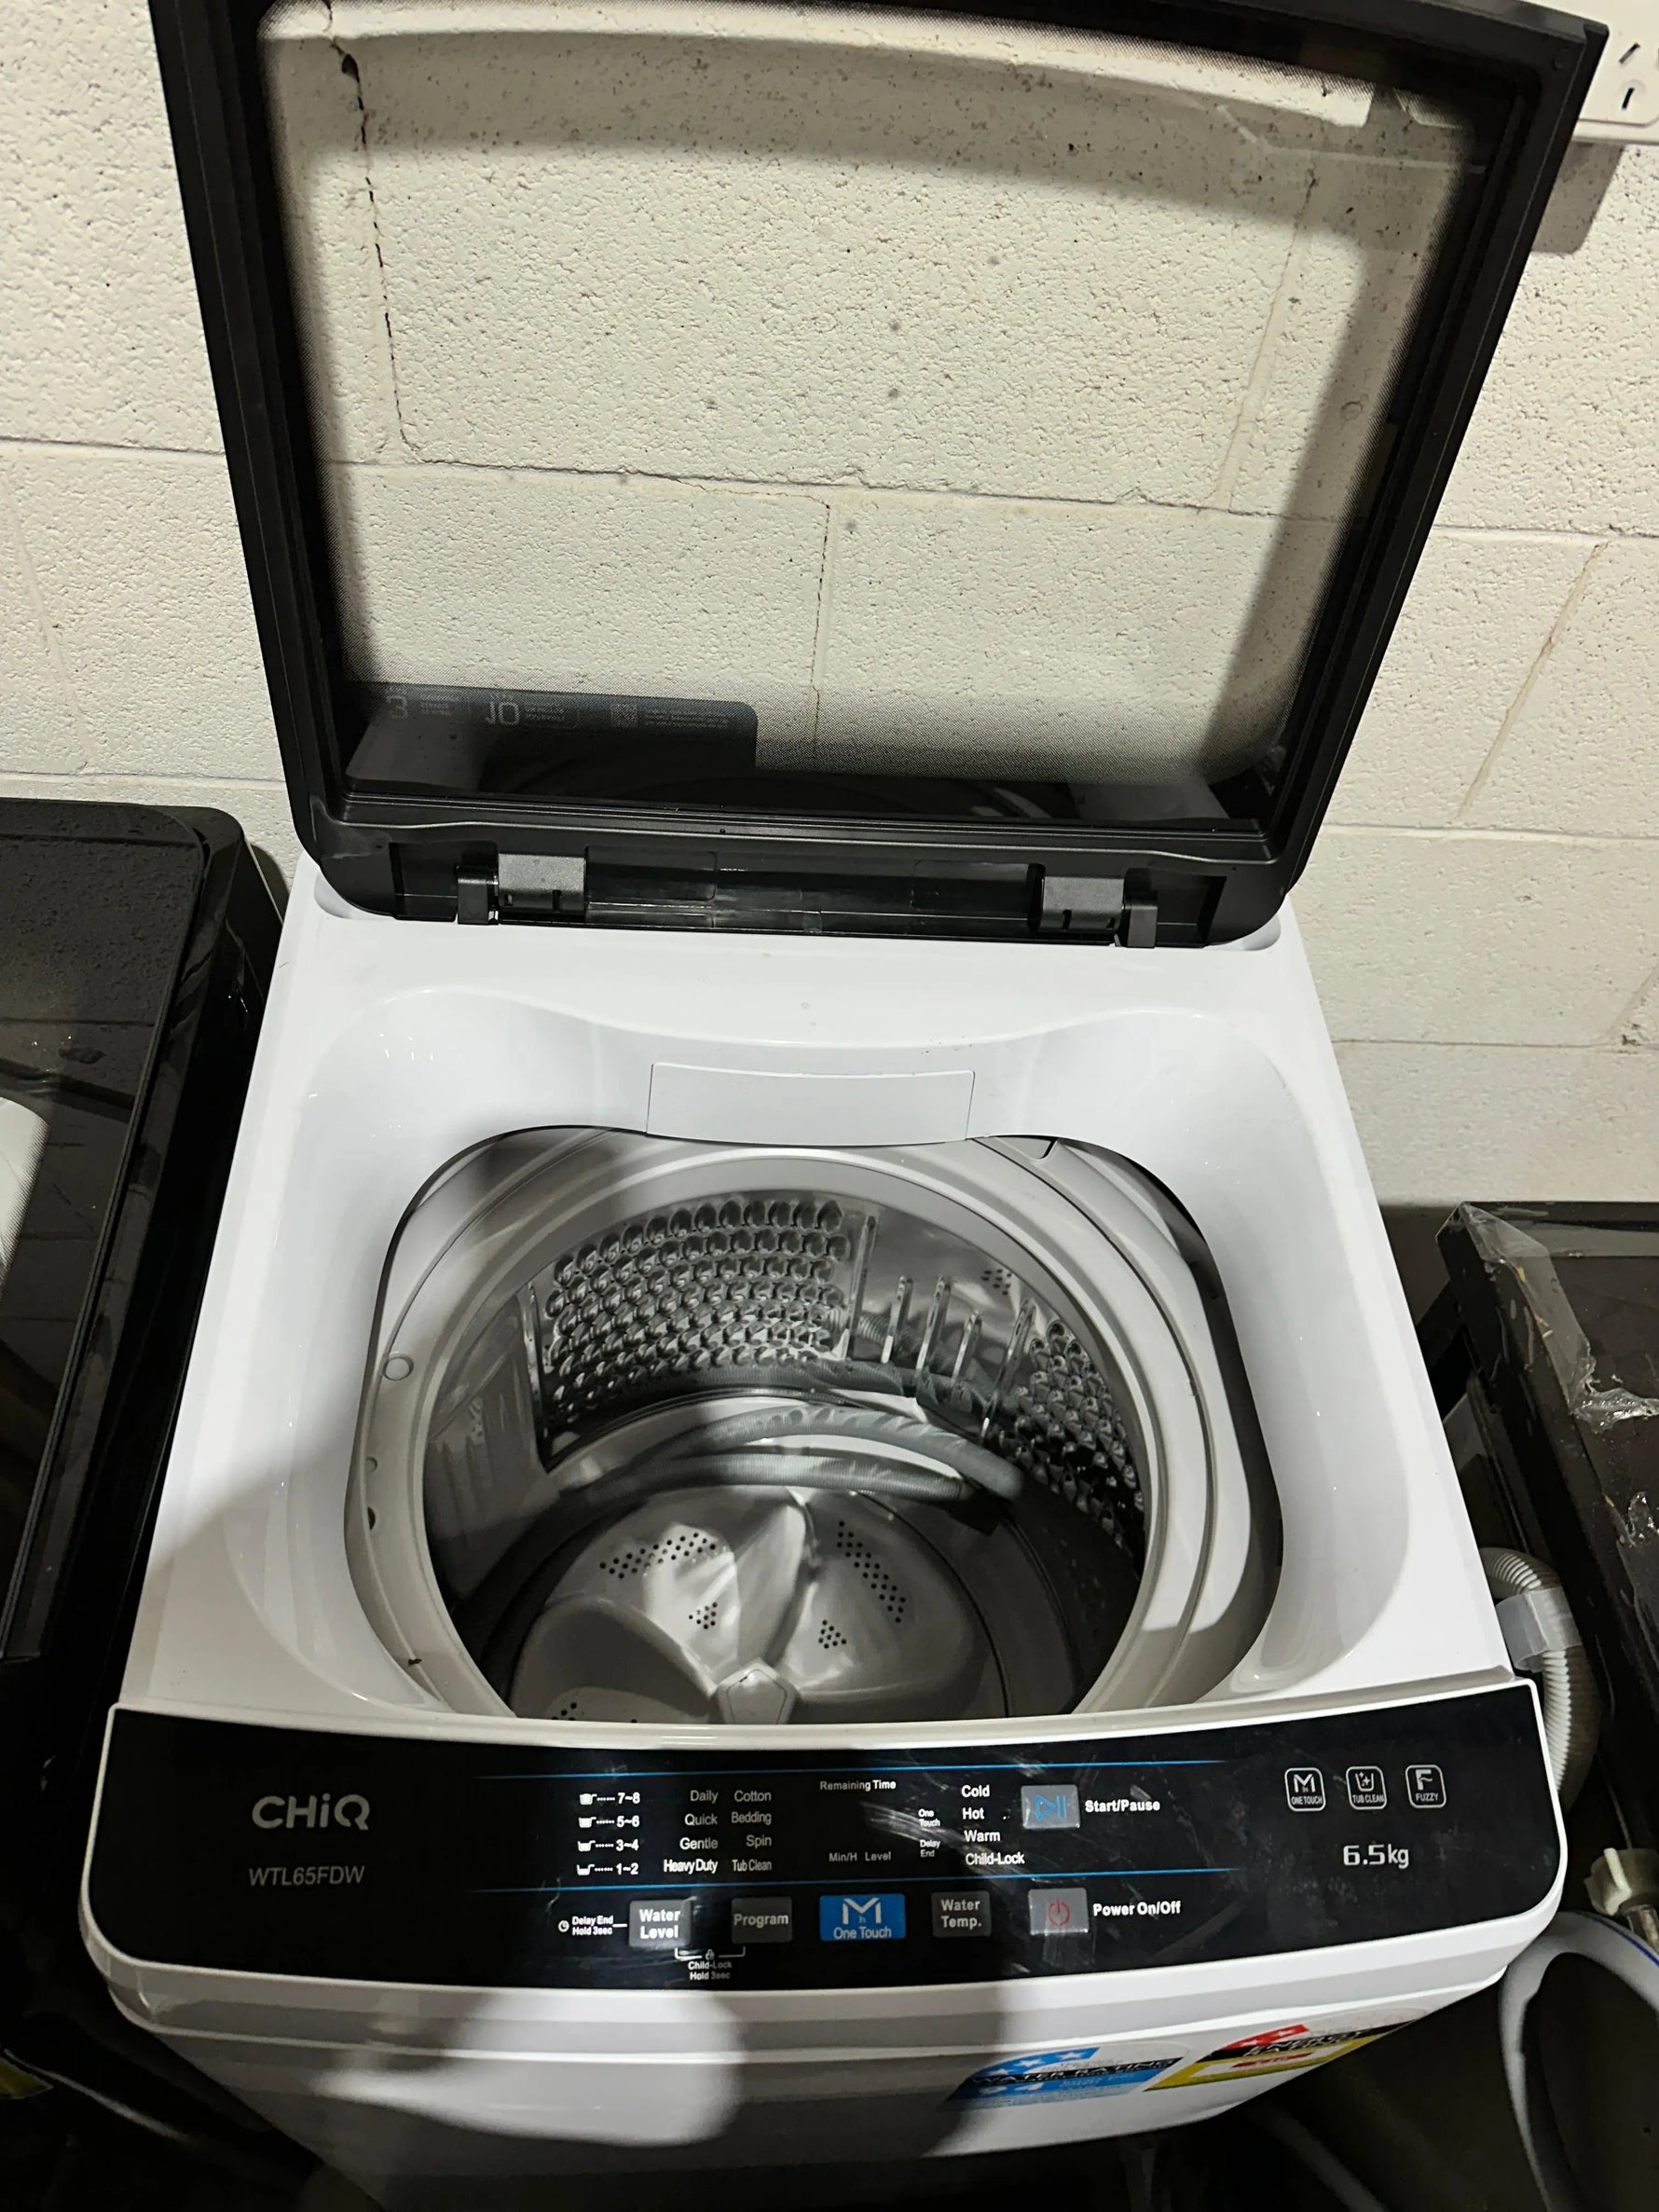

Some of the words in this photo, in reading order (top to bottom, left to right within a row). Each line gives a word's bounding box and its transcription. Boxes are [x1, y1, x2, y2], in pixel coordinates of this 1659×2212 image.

[819, 1779, 871, 1792] Remaining
[872, 1779, 897, 1790] Time
[961, 1784, 990, 1797] Cold
[617, 1792, 640, 1804] 7~8
[690, 1790, 719, 1804] Daily
[734, 1790, 772, 1803] Cotton
[1291, 1796, 1305, 1805] ONE
[1305, 1795, 1323, 1805] TOUCH
[1352, 1794, 1364, 1804] TUB
[1365, 1794, 1385, 1803] CLEAN
[1416, 1793, 1439, 1802] FUZZY
[1084, 1799, 1160, 1813] Start/Pause
[684, 1813, 718, 1826] Quick
[731, 1811, 772, 1825] Bedding
[918, 1808, 935, 1818] One
[962, 1807, 985, 1820] Hot
[919, 1819, 940, 1827] Touch
[679, 1836, 719, 1850] Gentle
[746, 1834, 772, 1848] Spin
[964, 1830, 1001, 1843] Warm
[616, 1839, 639, 1851] 3~4
[919, 1839, 940, 1848] Delay
[829, 1851, 857, 1862] Min/H
[865, 1850, 891, 1862] Level
[920, 1849, 935, 1858] End
[966, 1851, 1025, 1865] Child-Lock
[1343, 1844, 1410, 1869] 6.5kg
[616, 1862, 639, 1875] 1~2
[732, 1860, 747, 1872] Tub
[748, 1860, 772, 1872] Clean
[249, 1865, 365, 1887] WTL65FDW
[939, 1898, 980, 1912] Water
[1092, 1903, 1134, 1917] Power
[1137, 1901, 1181, 1916] On/Off
[571, 1916, 596, 1927] Delay
[596, 1915, 613, 1924] End
[639, 1909, 681, 1922] Water
[734, 1914, 789, 1929] Program
[940, 1916, 982, 1930] Temp.
[572, 1927, 592, 1935] Hold
[593, 1926, 612, 1935] 3sec
[640, 1925, 679, 1939] Level
[833, 1927, 857, 1940] One
[859, 1926, 892, 1939] Touch
[688, 1960, 732, 1970] Child-Lock
[690, 1972, 709, 1980] Hold
[710, 1971, 731, 1979] 3sec
